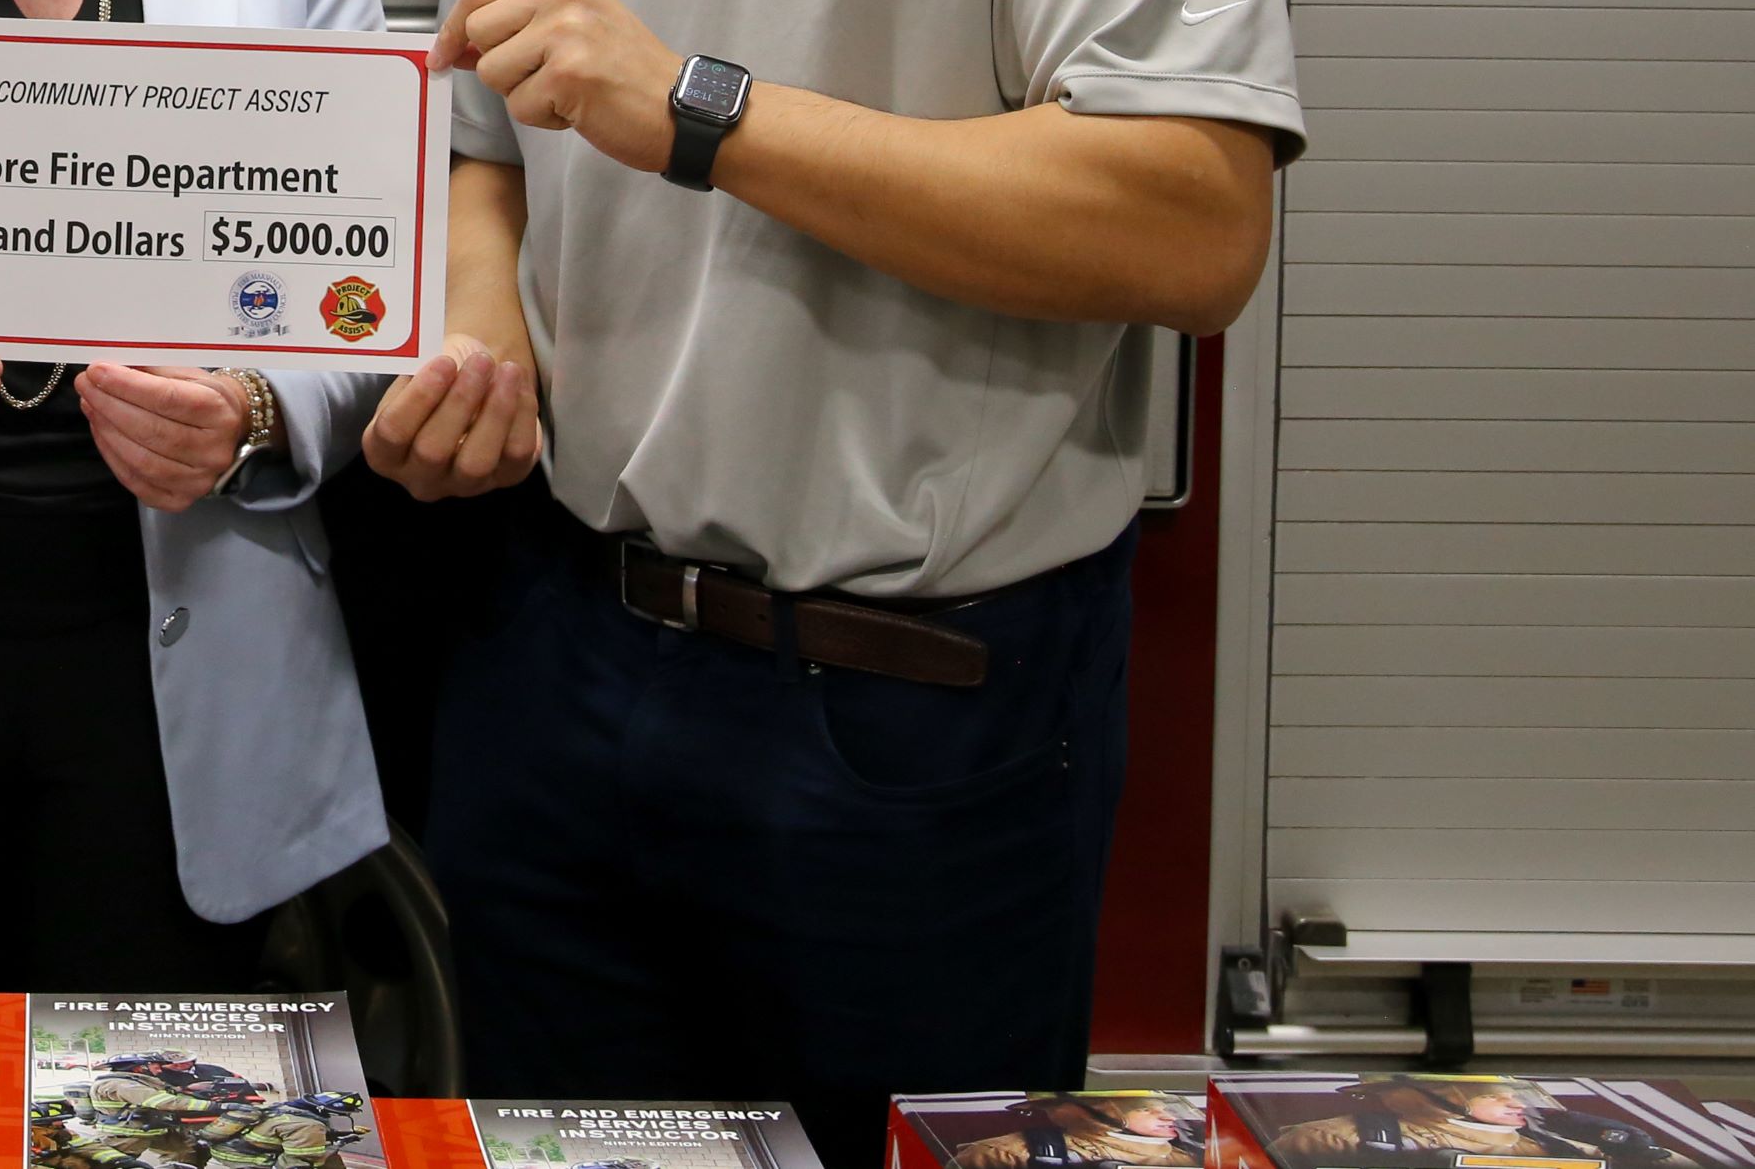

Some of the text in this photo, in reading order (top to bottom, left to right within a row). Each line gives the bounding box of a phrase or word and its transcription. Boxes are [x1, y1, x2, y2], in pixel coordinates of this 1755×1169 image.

[142, 85, 242, 111] PROJECT
[244, 89, 330, 114] ASSIST
[50, 151, 116, 188] Fire
[126, 154, 339, 198] Department
[66, 220, 185, 258] Dollars
[210, 215, 390, 259] $5,000.00
[336, 284, 371, 296] PROJECT
[339, 324, 365, 334] ASSIST
[53, 1002, 335, 1012] FIRE AND EMERGENCY
[131, 1012, 260, 1022] SERVICES
[109, 1022, 285, 1033] INSTRUCTOR
[497, 1108, 781, 1121] FIRE AND EMERGENCY
[579, 1119, 711, 1130] SERVICES
[559, 1129, 740, 1141] INSTRUCTOR
